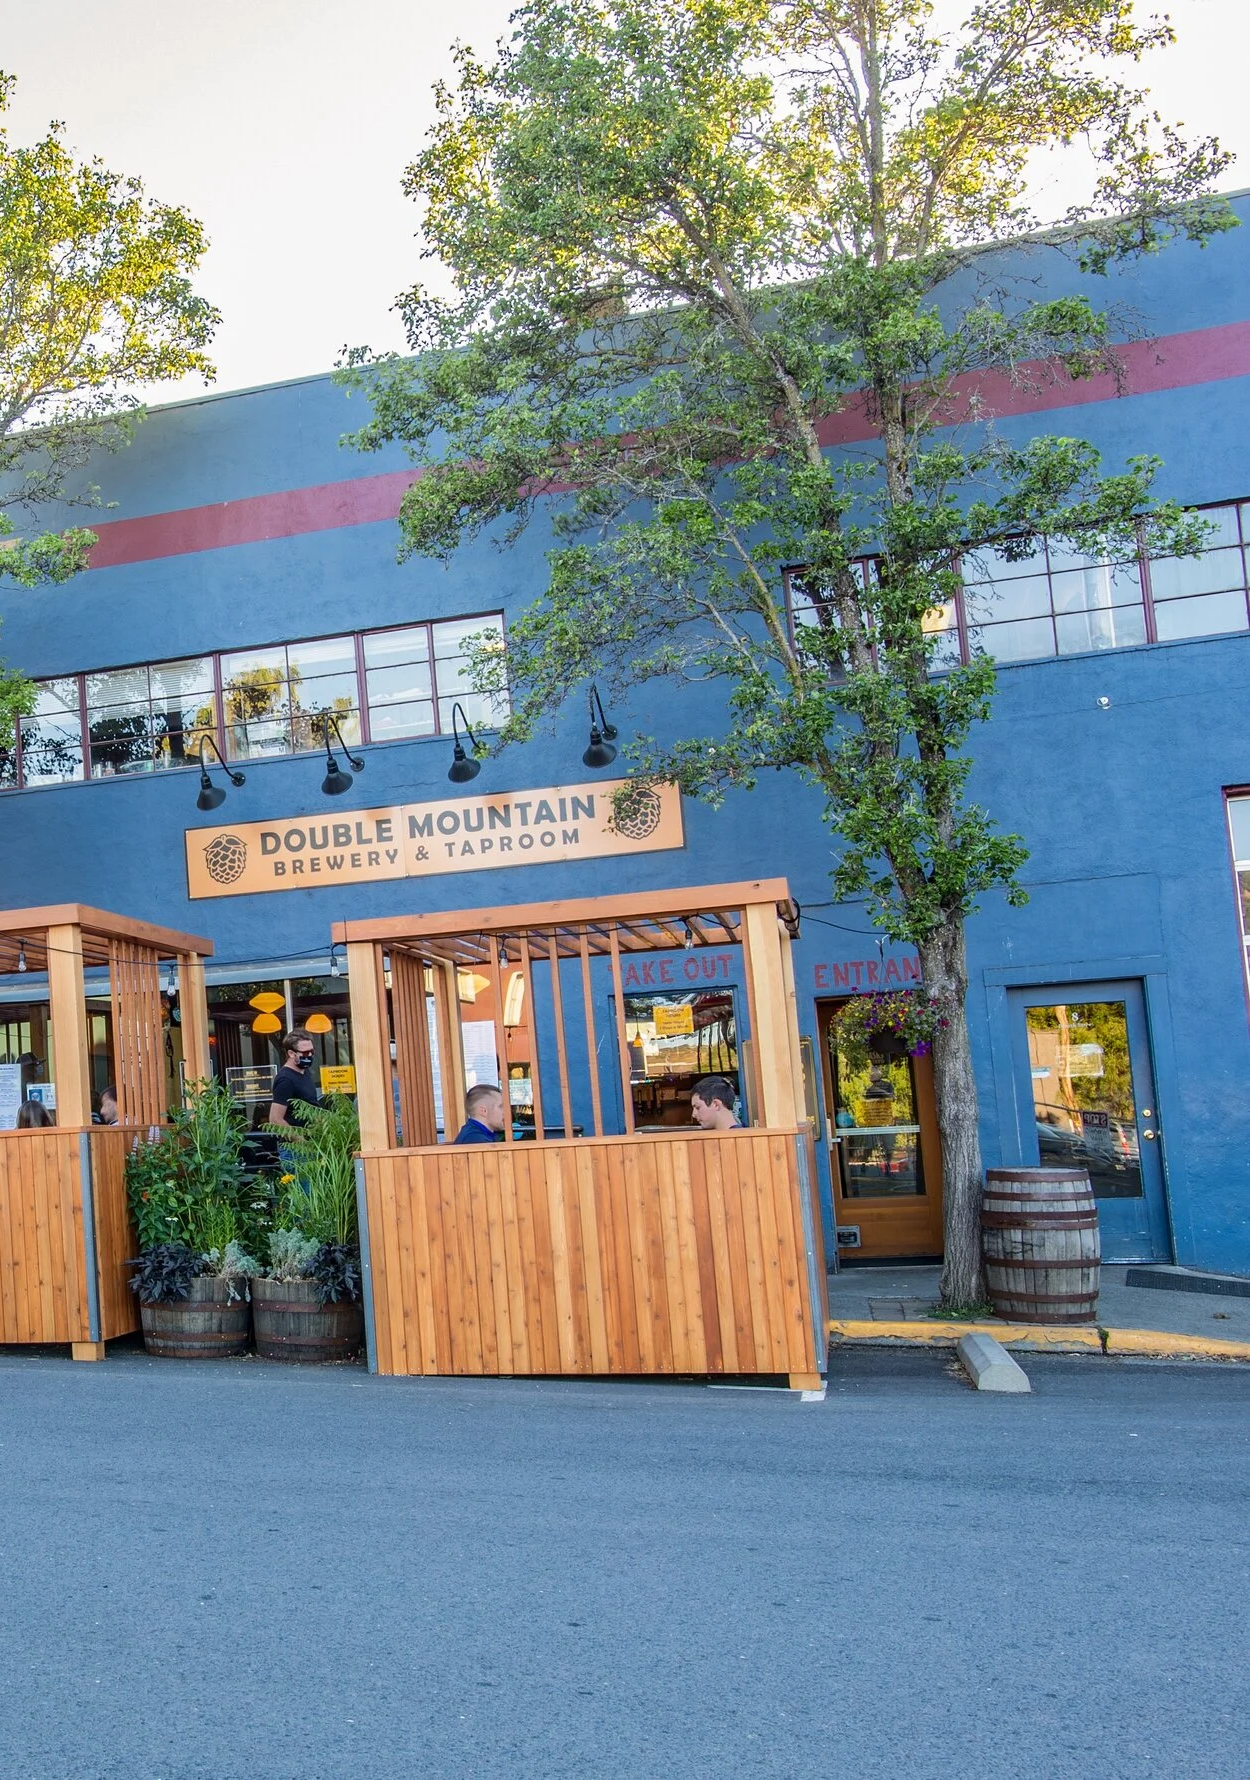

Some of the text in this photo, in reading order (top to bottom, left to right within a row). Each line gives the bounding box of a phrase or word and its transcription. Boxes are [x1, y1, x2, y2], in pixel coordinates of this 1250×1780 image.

[260, 794, 596, 856] DOUBLE MOUNTAIN
[273, 828, 580, 877] BREWERY & TAPROOM
[683, 954, 734, 980] OUT
[814, 956, 924, 989] ENTRAN
[1071, 1011, 1080, 1021] 8
